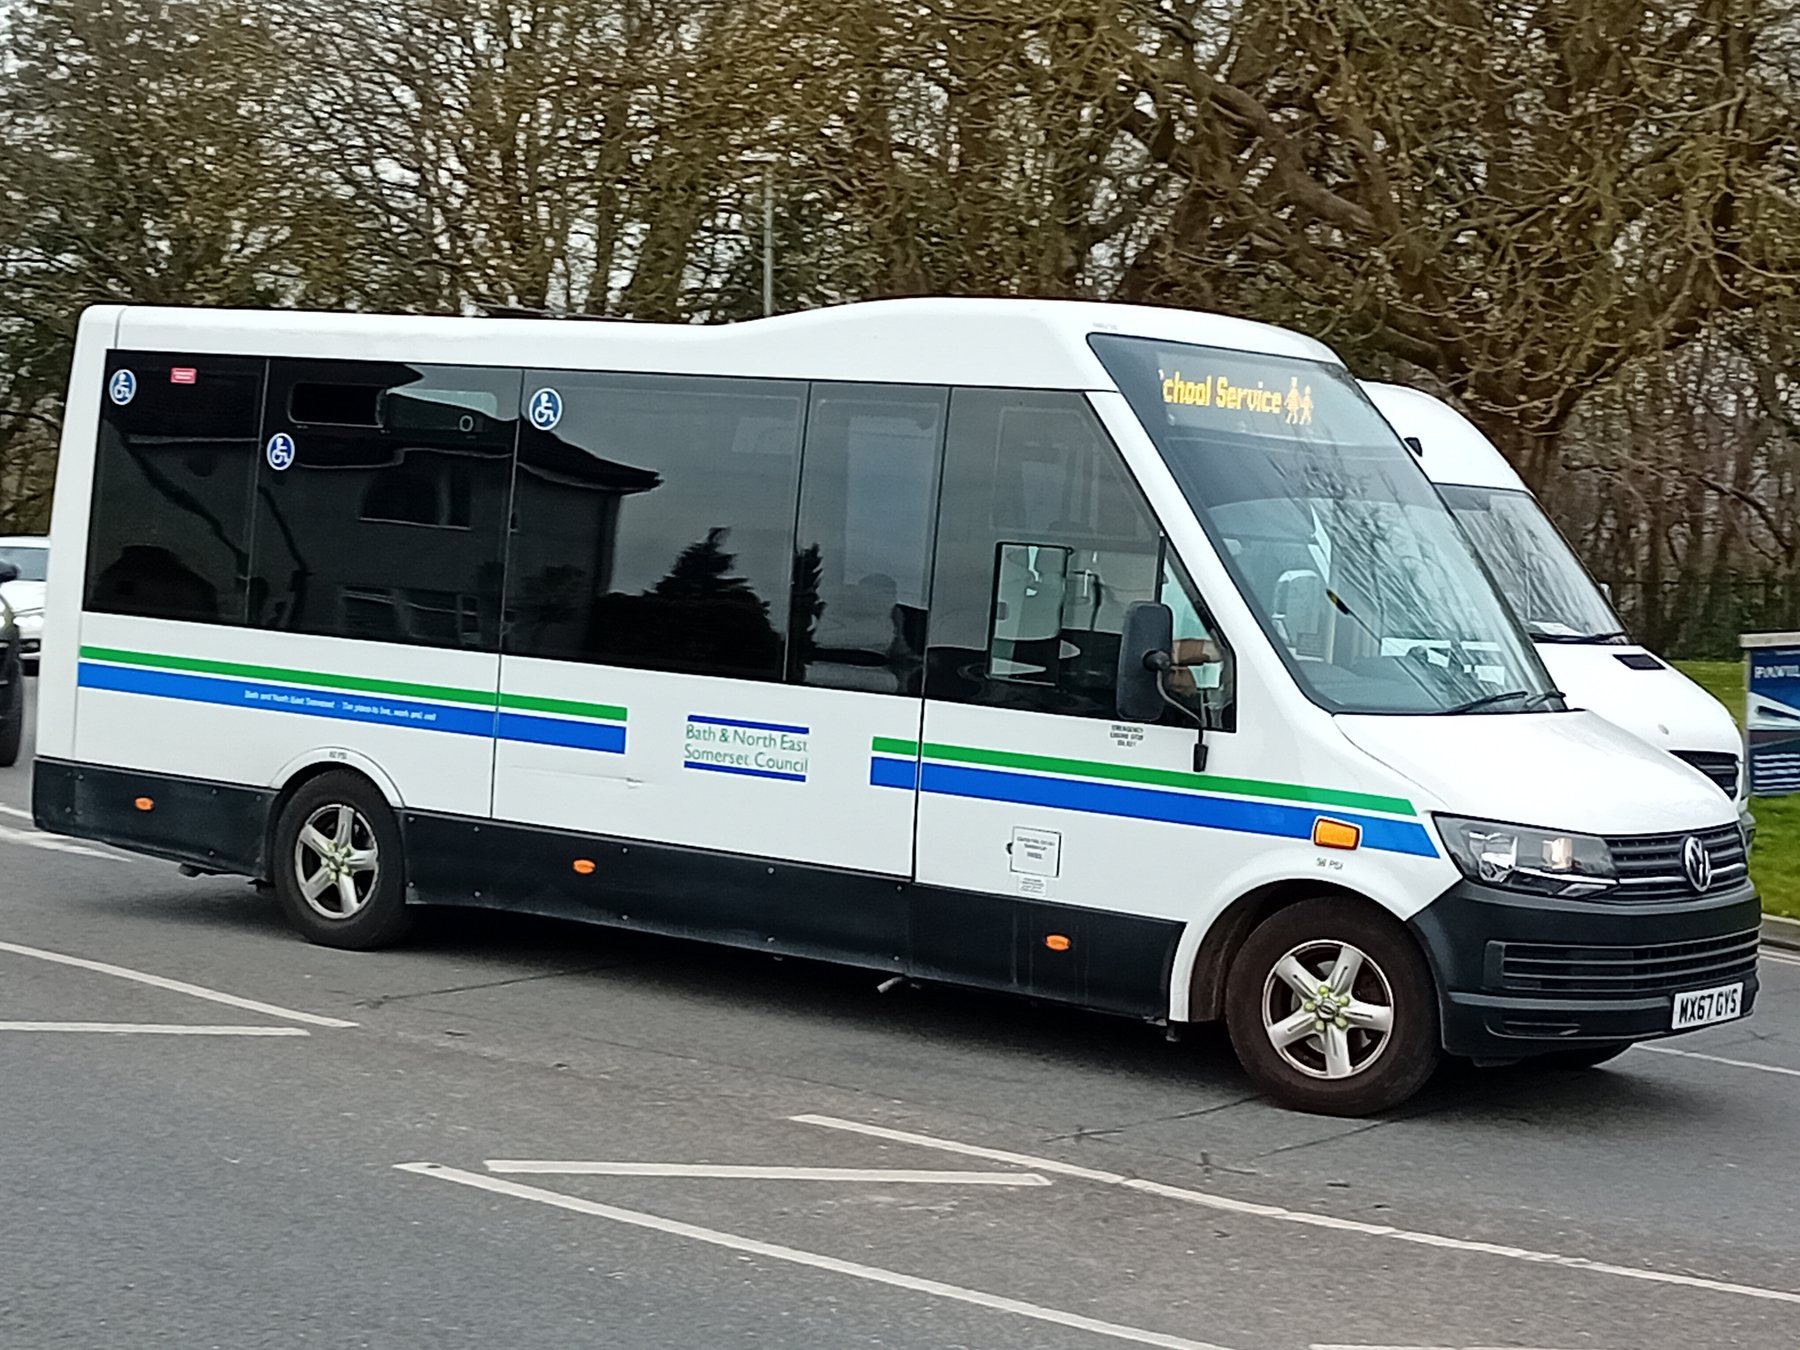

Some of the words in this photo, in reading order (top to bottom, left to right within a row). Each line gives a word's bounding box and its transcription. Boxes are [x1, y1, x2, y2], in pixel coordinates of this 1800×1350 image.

[1158, 369, 1213, 406] chool
[1215, 376, 1282, 414] Service
[686, 724, 716, 742] Bath
[719, 728, 730, 743] &
[733, 729, 777, 749] North
[780, 734, 808, 752] East
[684, 743, 750, 766] Somerset
[754, 752, 809, 773] Council
[1679, 993, 1714, 1024] MX67
